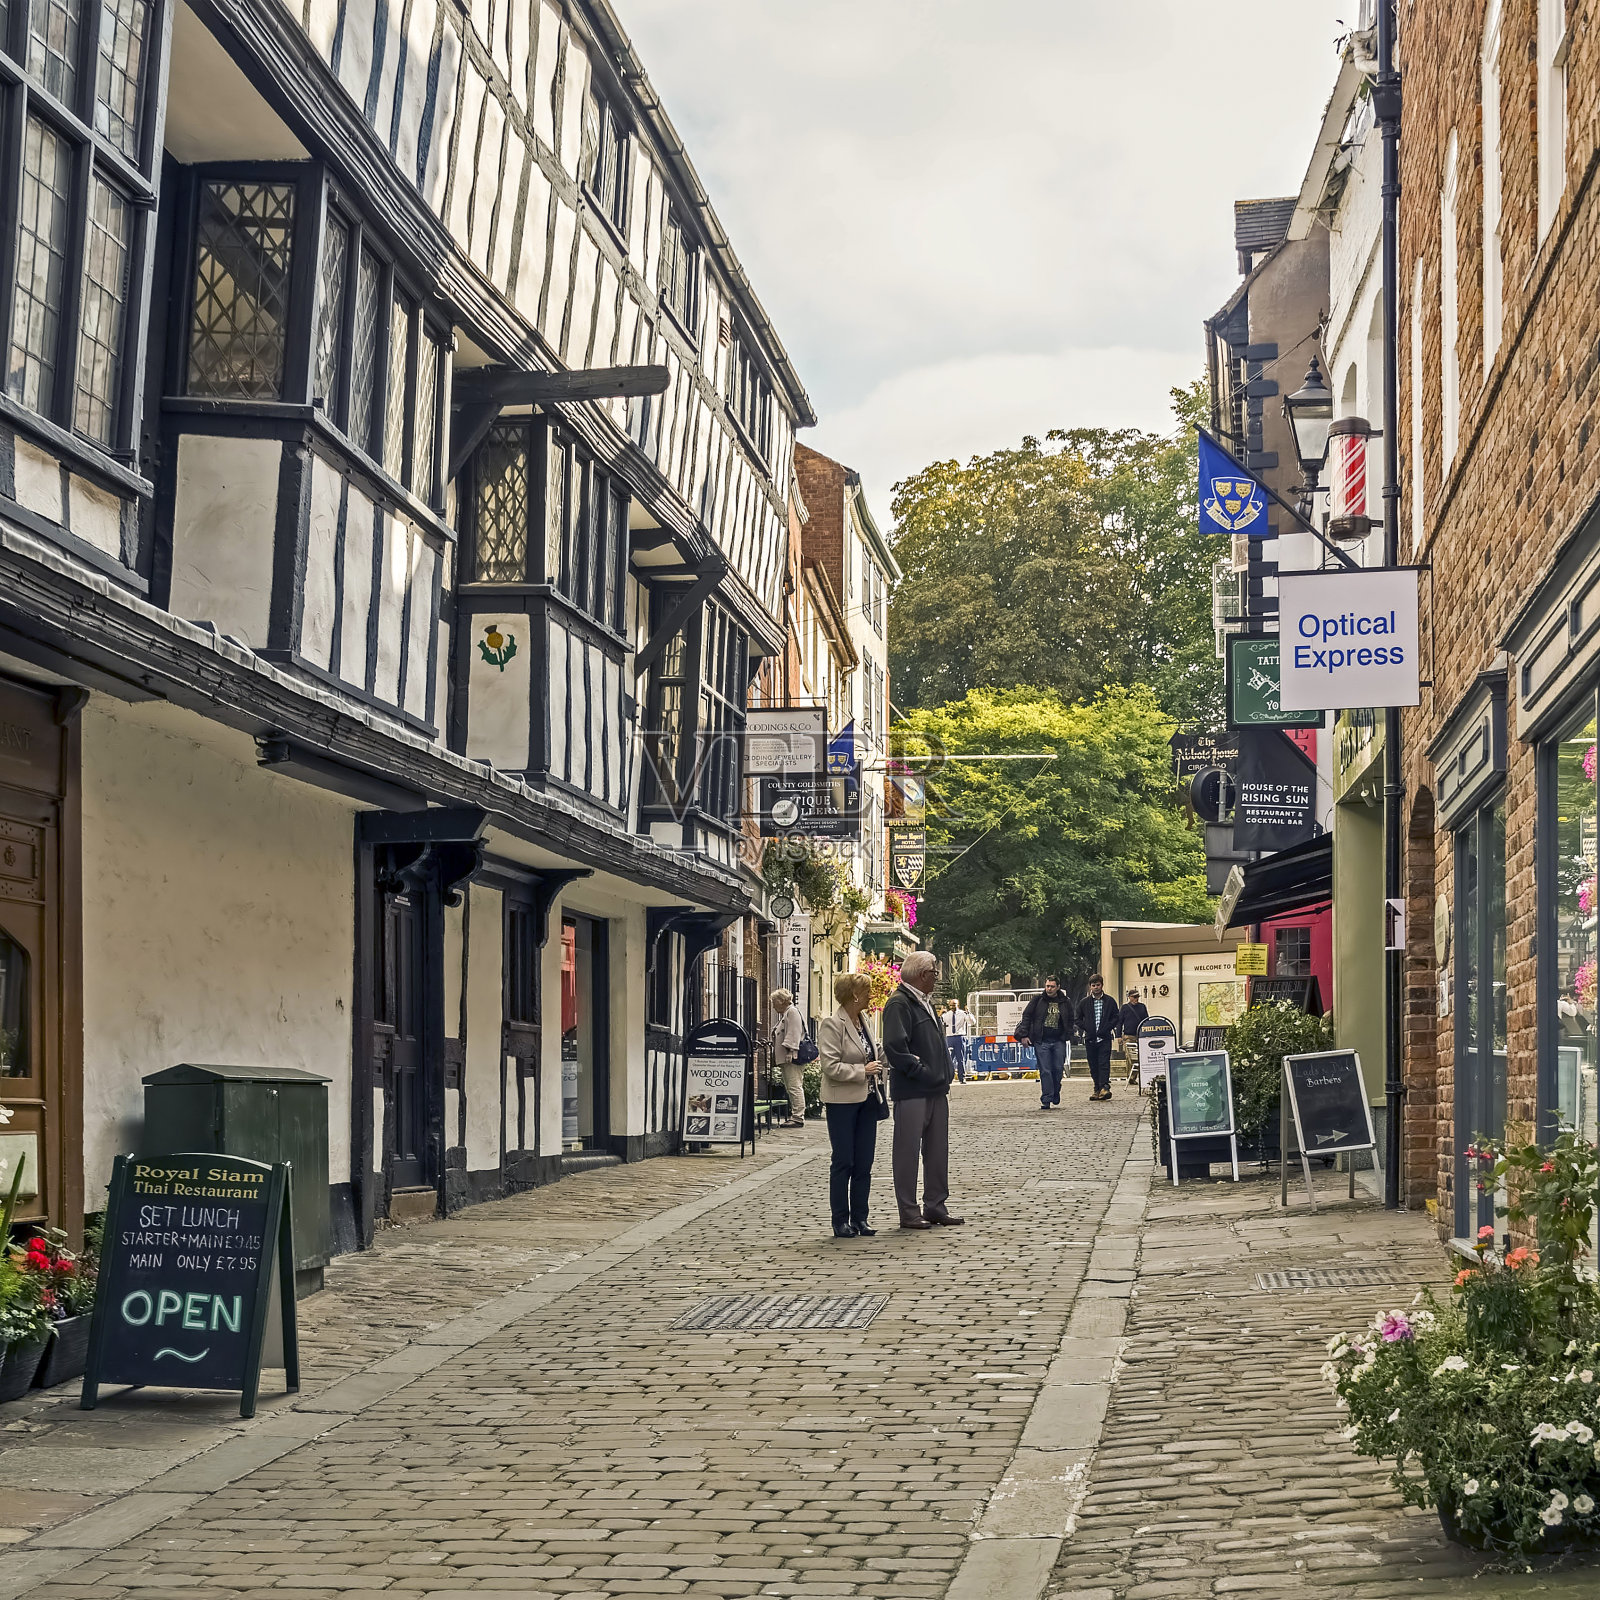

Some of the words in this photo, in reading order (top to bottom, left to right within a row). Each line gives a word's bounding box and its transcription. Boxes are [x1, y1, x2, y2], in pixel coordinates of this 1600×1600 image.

[1298, 610, 1396, 643] Optical
[1257, 656, 1280, 665] TATT
[1294, 645, 1404, 674] Express
[1197, 736, 1216, 747] The
[1242, 783, 1274, 791] HOUSE
[1291, 785, 1309, 793] THE
[1241, 793, 1280, 803] RISING
[1285, 795, 1309, 804] SUN
[1137, 962, 1165, 977] WC
[690, 1069, 742, 1079] WOODINGS
[134, 1165, 200, 1182] Royal
[207, 1168, 264, 1183] Siam
[133, 1180, 169, 1195] Thai
[173, 1183, 259, 1199] Restaurant
[139, 1205, 177, 1228] SET
[181, 1206, 240, 1230] LUNCH
[129, 1253, 163, 1269] MAIN
[176, 1255, 211, 1272] ONLY
[215, 1256, 257, 1270] £7.95
[120, 1289, 242, 1333] OPEN
